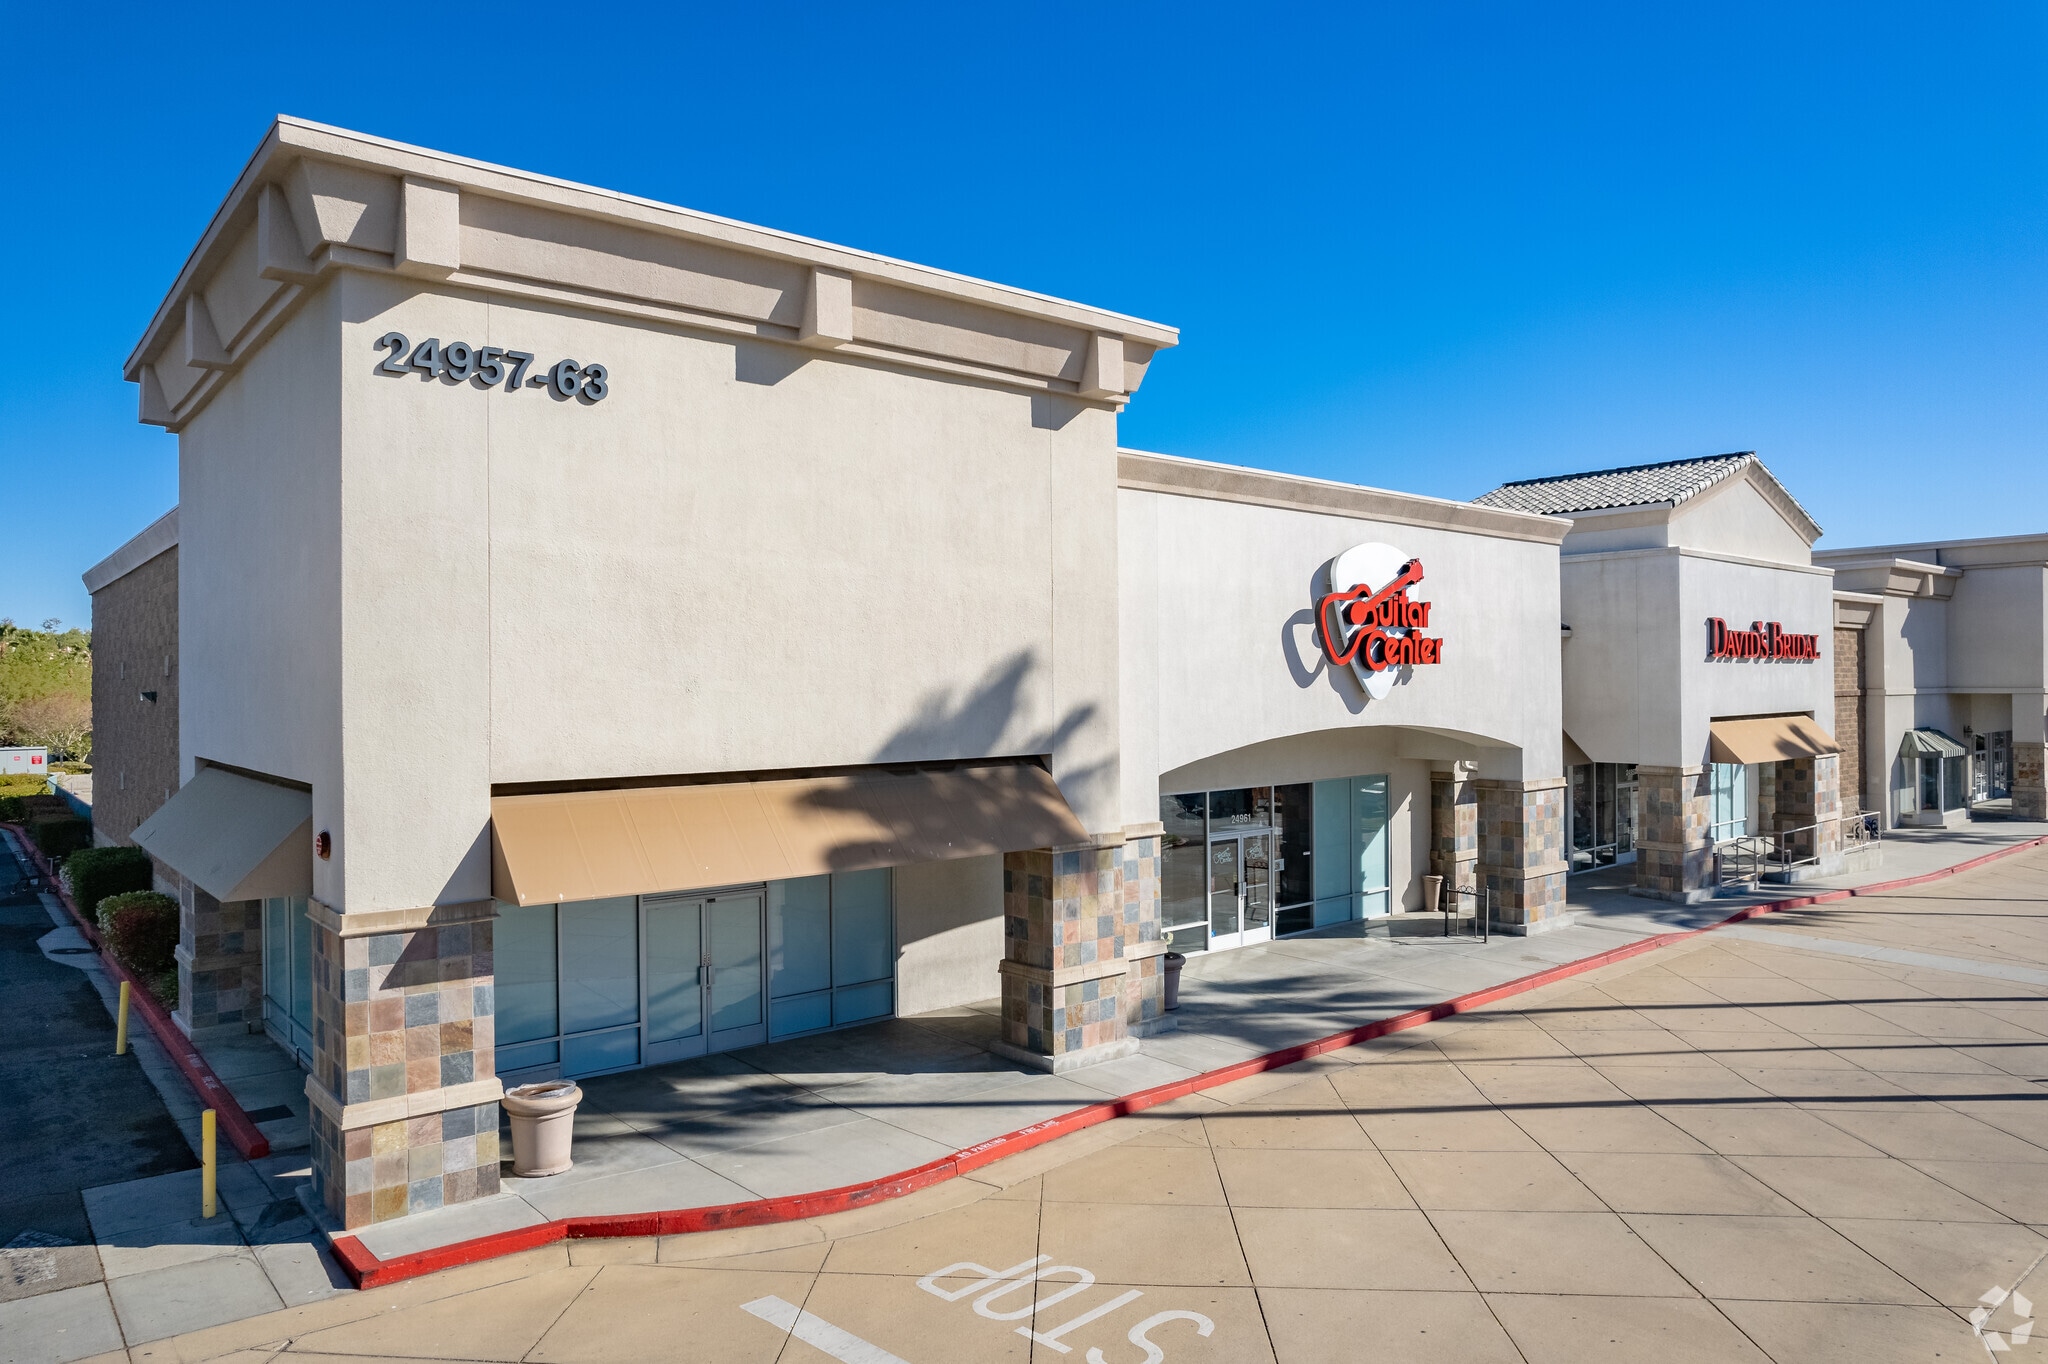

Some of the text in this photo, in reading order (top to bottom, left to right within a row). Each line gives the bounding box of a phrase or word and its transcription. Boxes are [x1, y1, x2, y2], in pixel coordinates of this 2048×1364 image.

[378, 331, 609, 401] 24957-63
[1317, 558, 1432, 666] Guitar
[1709, 616, 1821, 659] DAVID'S BRIDAL
[1362, 629, 1443, 672] Center
[1231, 813, 1252, 824] 24961
[915, 1253, 1215, 1364] STOP
